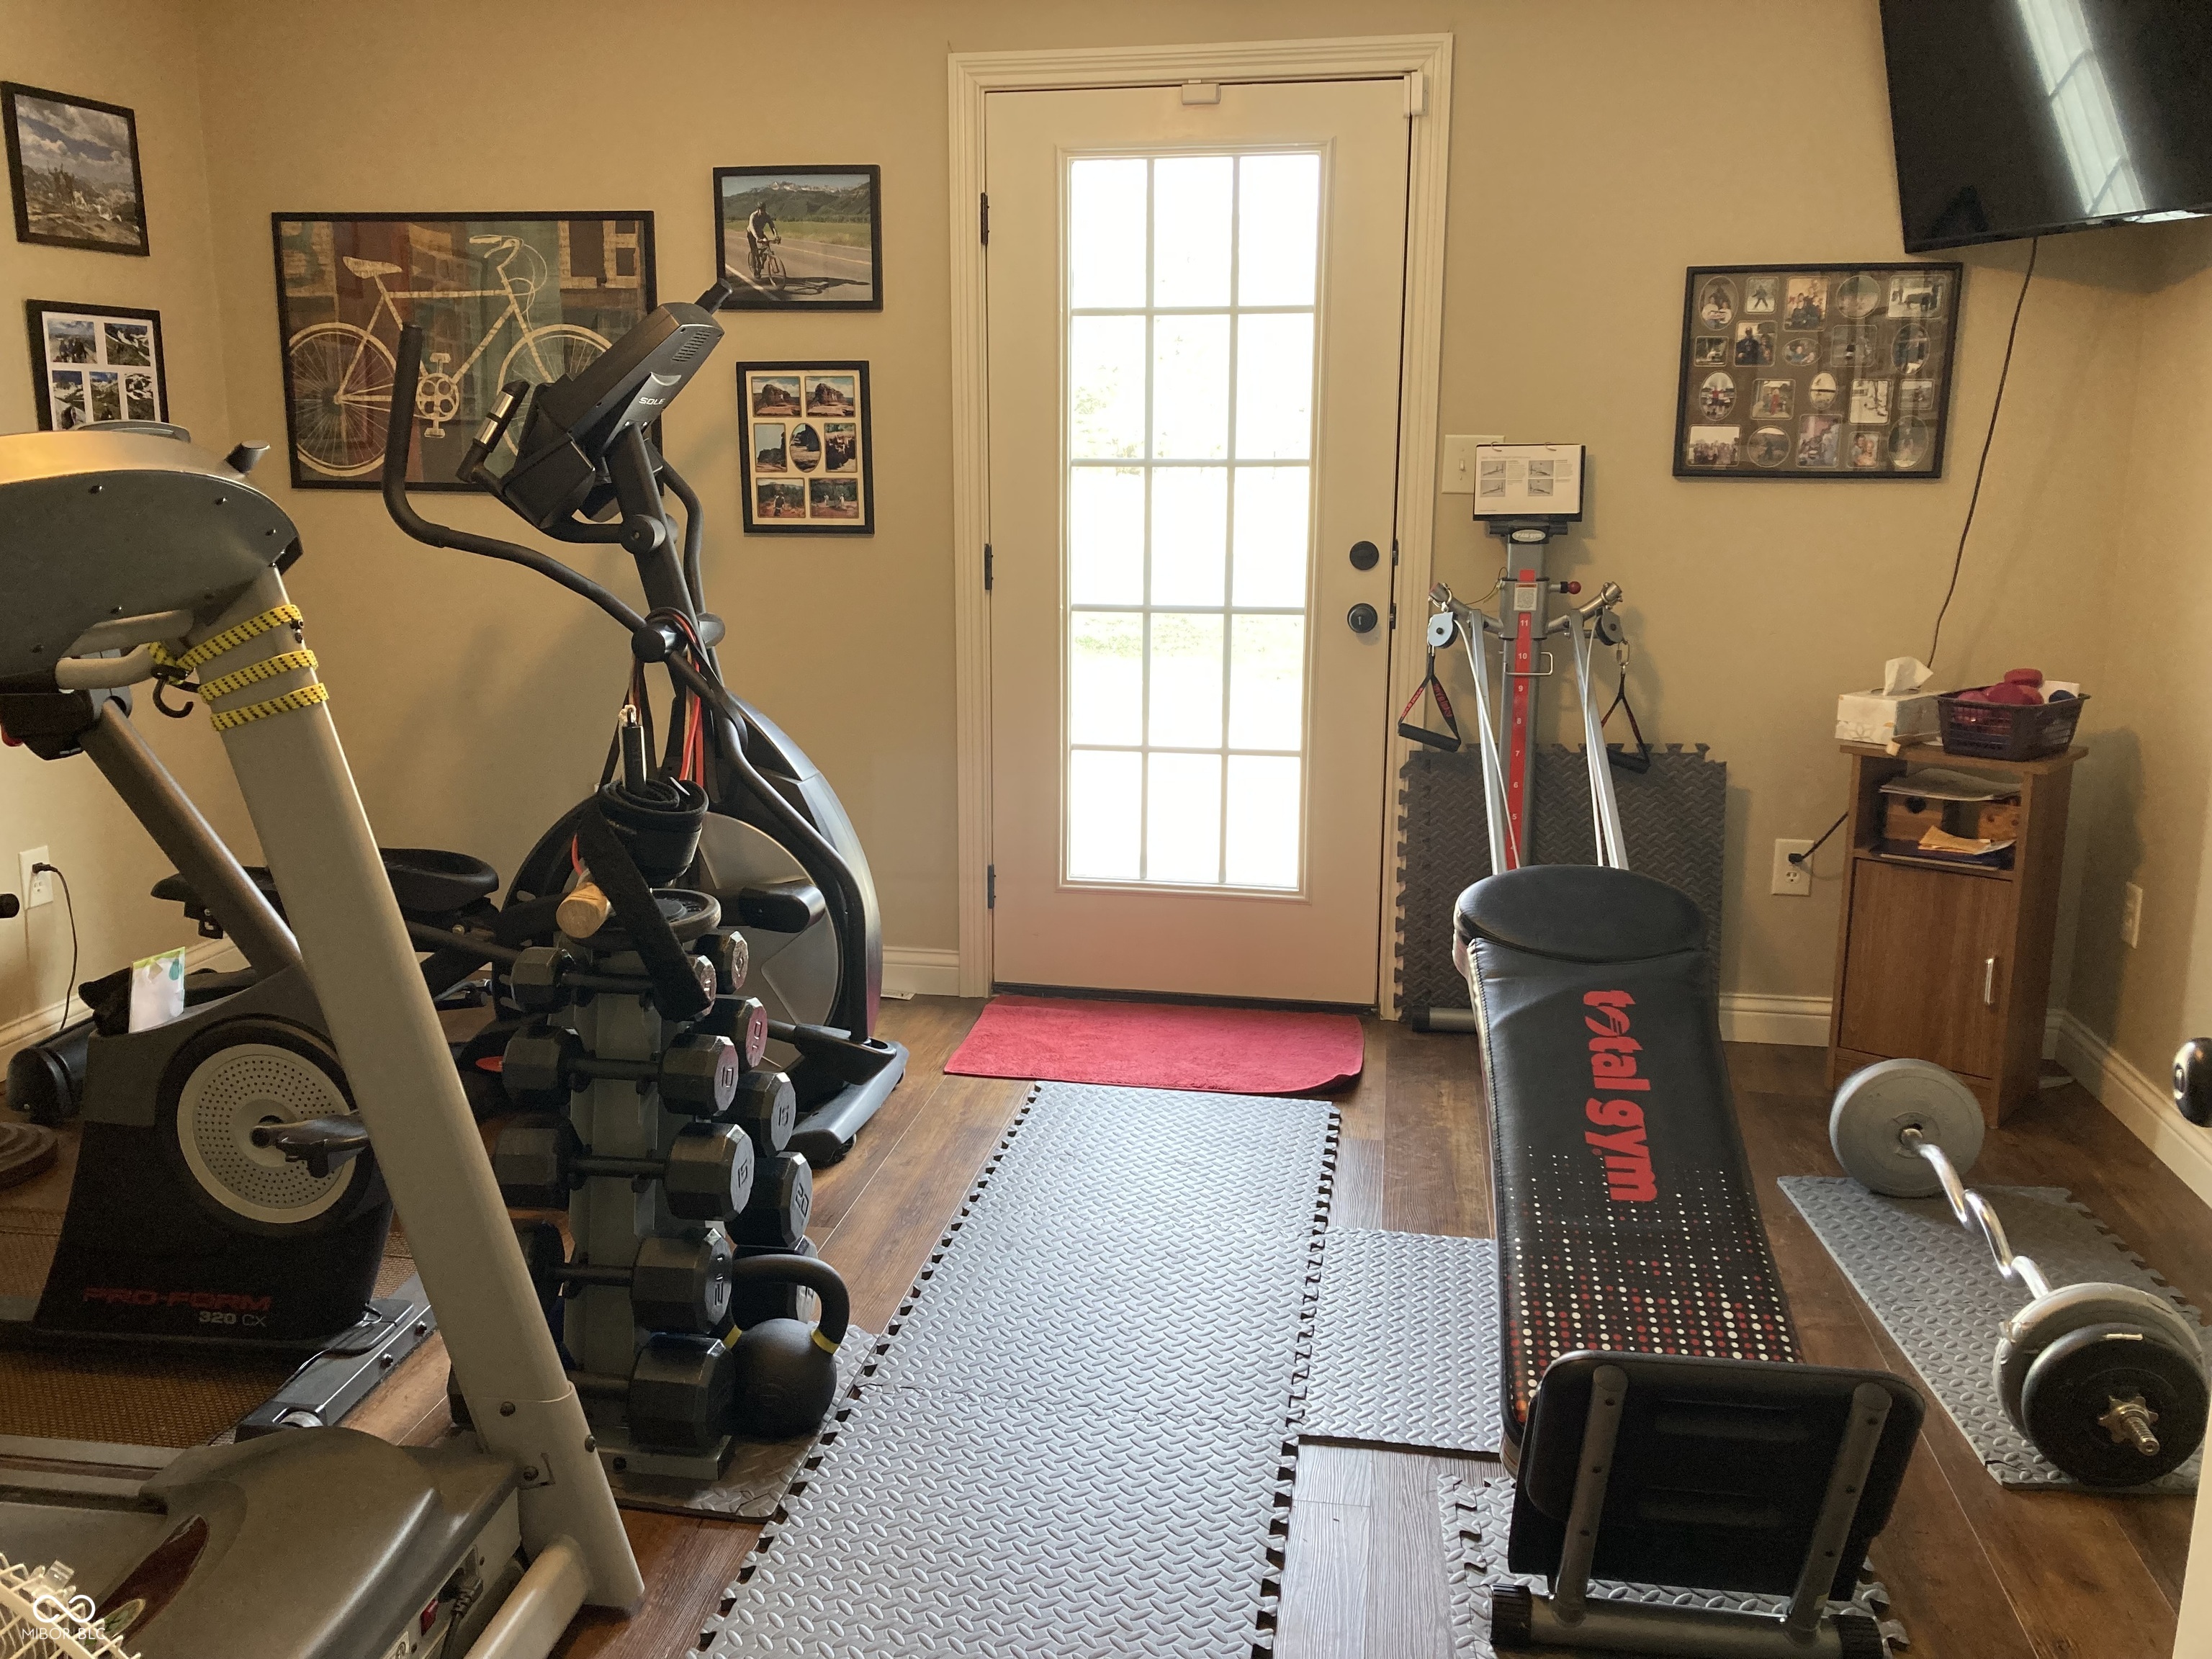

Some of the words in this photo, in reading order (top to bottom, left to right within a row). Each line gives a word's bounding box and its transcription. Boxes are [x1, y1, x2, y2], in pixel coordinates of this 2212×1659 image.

[638, 397, 666, 405] SOLE
[721, 1066, 733, 1088] 10
[778, 1105, 789, 1126] 15
[1585, 1098, 1658, 1202] gym
[737, 1159, 748, 1188] 15
[795, 1182, 809, 1218] 20
[199, 1310, 237, 1325] 320
[242, 1313, 266, 1327] CX
